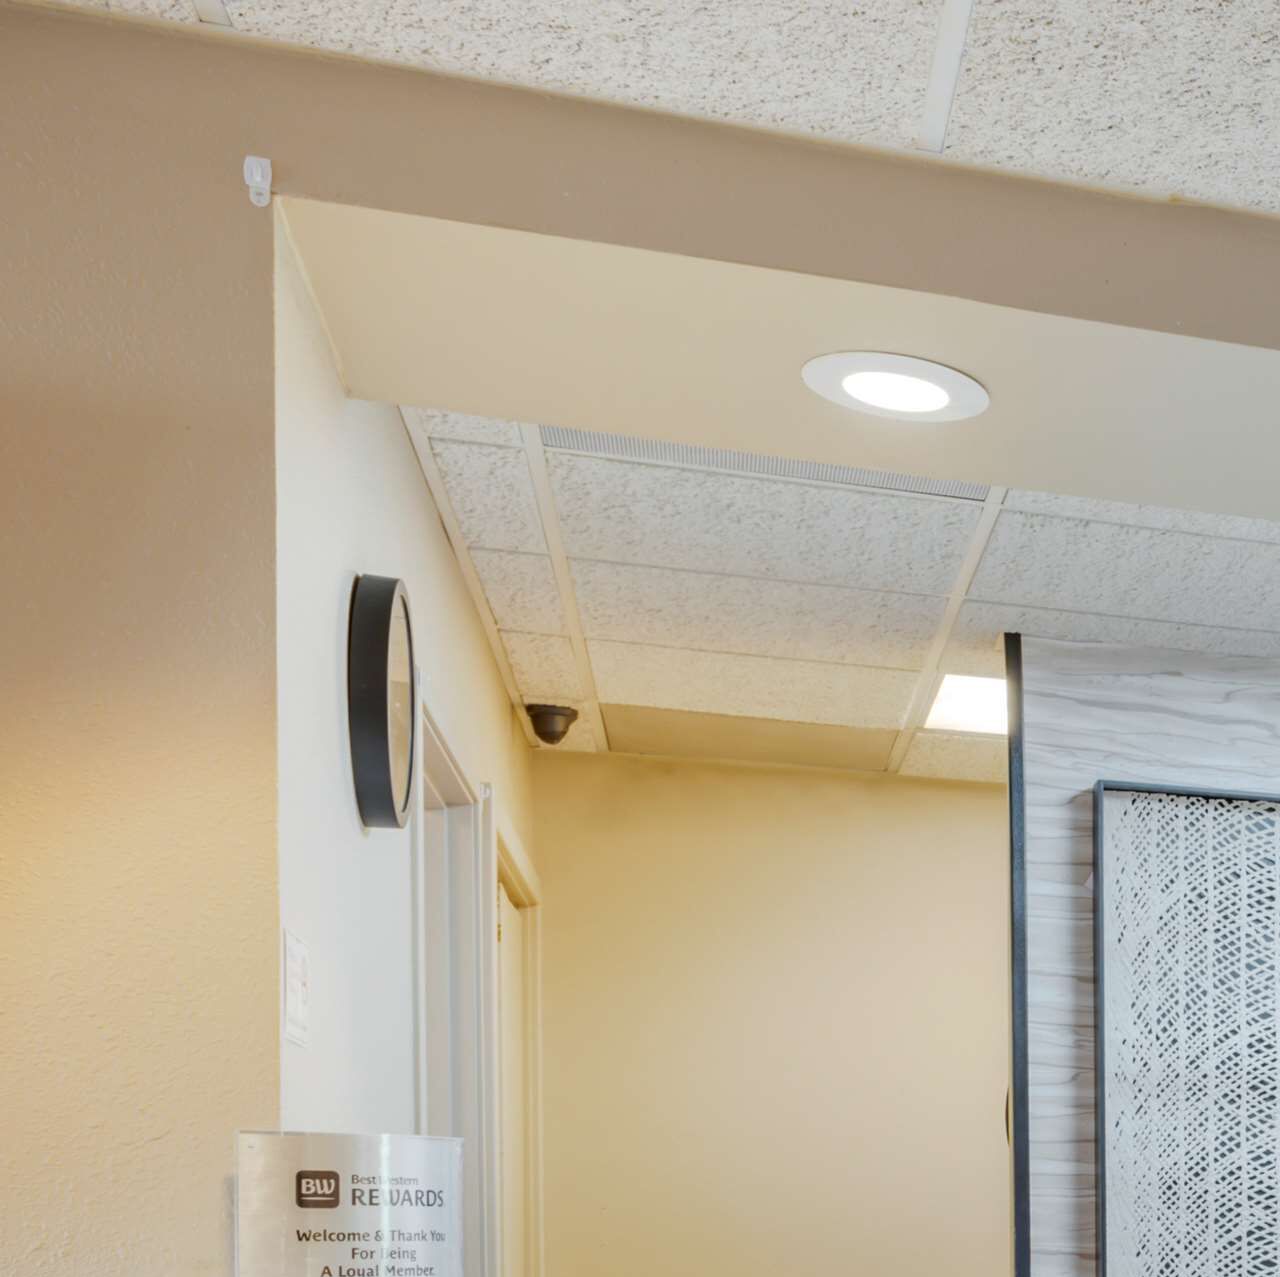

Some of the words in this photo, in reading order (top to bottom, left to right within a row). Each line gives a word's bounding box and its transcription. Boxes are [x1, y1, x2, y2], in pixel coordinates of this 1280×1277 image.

[351, 1174, 376, 1185] Best
[379, 1174, 419, 1185] estern
[300, 1179, 336, 1195] BW
[351, 1188, 444, 1207] REWARDS
[296, 1229, 370, 1242] Welcome
[374, 1230, 383, 1242] &
[390, 1229, 427, 1242] Thank
[430, 1230, 446, 1242] You
[351, 1247, 376, 1260] For
[320, 1266, 333, 1277] A
